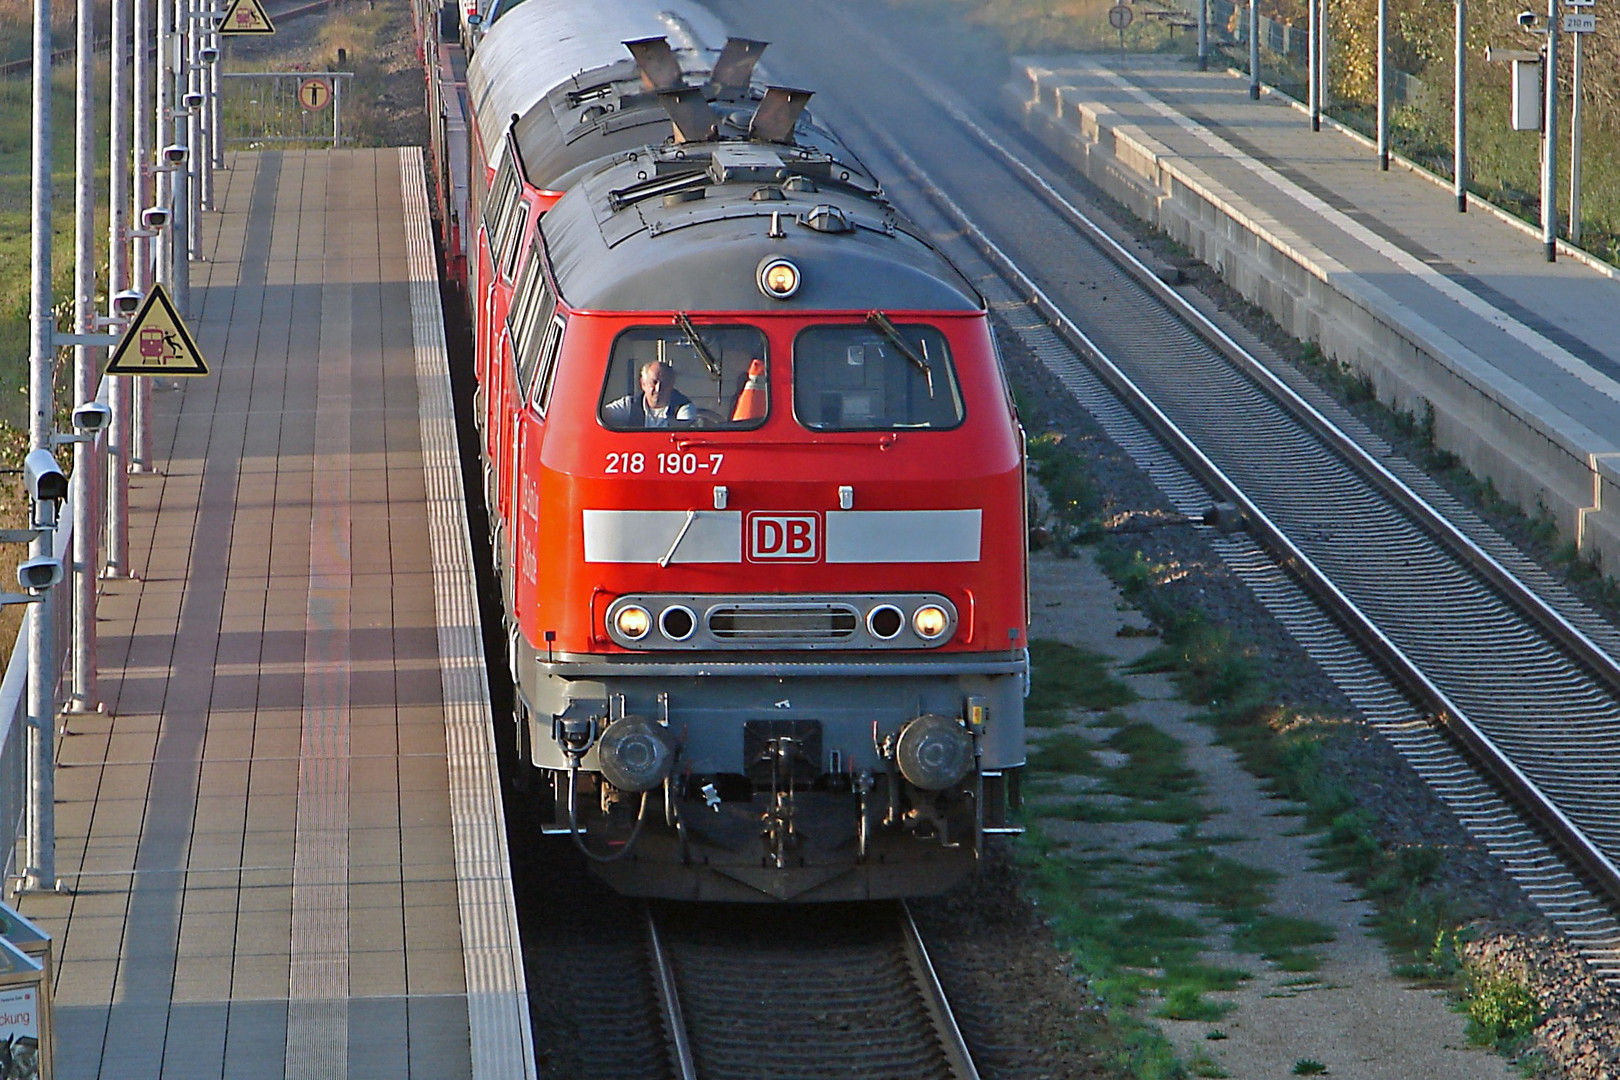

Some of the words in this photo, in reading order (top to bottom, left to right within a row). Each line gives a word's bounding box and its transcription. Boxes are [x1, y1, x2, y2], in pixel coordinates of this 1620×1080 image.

[1568, 19, 1581, 27] 210
[605, 452, 645, 474] 218
[657, 453, 724, 475] 190-7
[757, 520, 812, 554] DB
